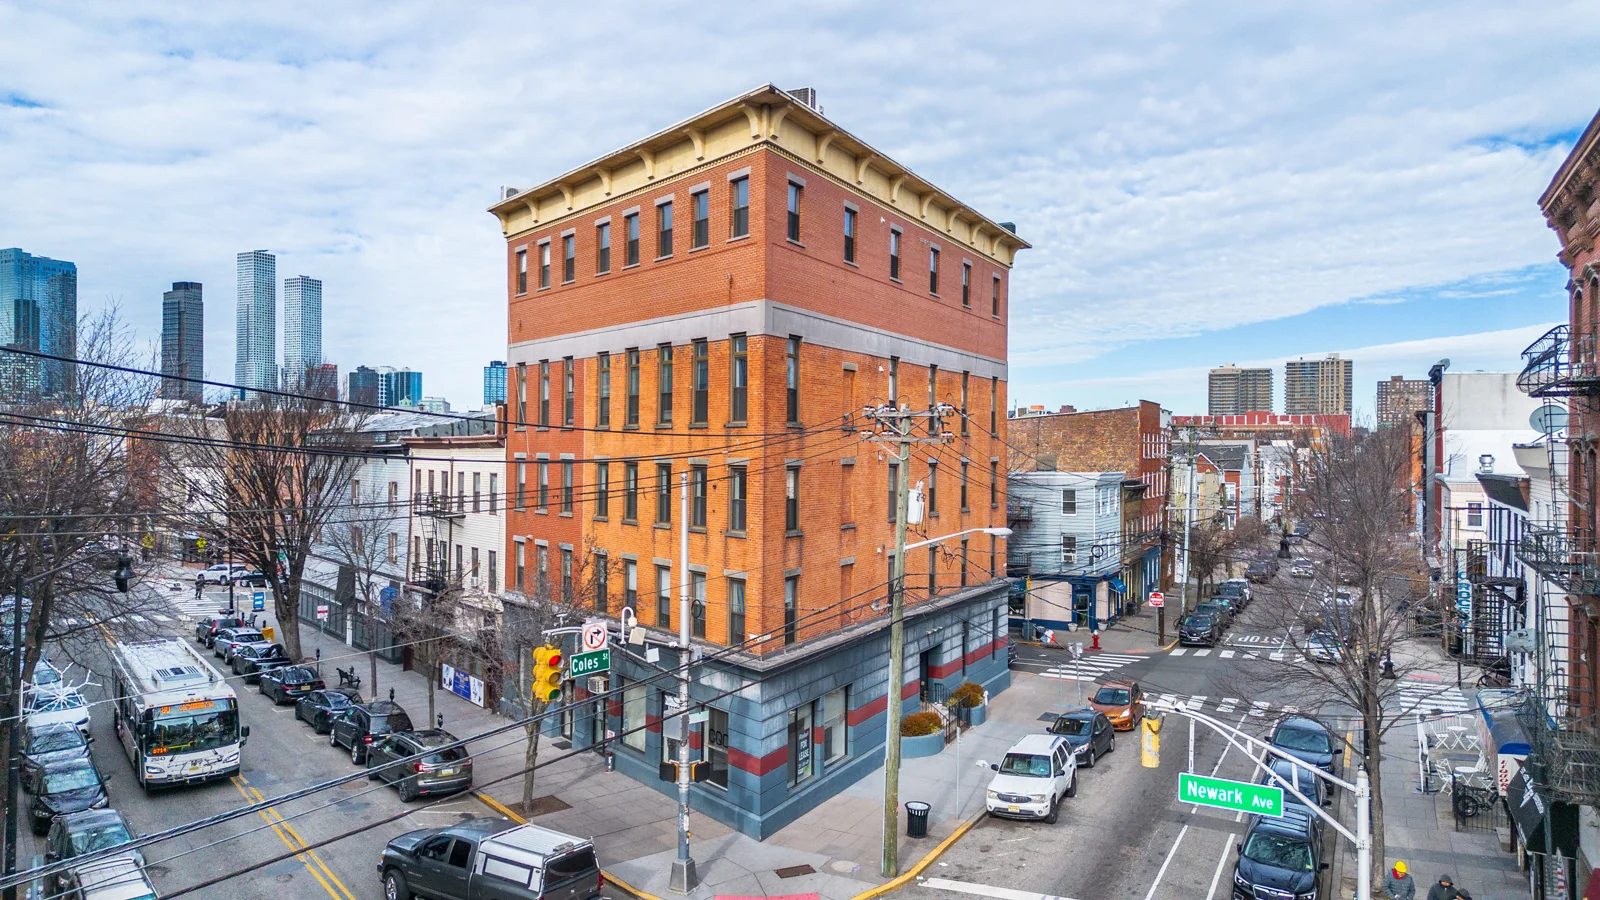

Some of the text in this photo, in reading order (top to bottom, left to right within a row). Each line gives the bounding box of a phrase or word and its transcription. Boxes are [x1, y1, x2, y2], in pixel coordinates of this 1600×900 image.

[1238, 635, 1282, 644] STOP
[572, 657, 599, 673] Coles
[800, 738, 808, 749] FOR
[798, 748, 809, 762] LEASE
[1499, 759, 1509, 792] LIQUORS
[1187, 780, 1274, 809] Newark Ave
